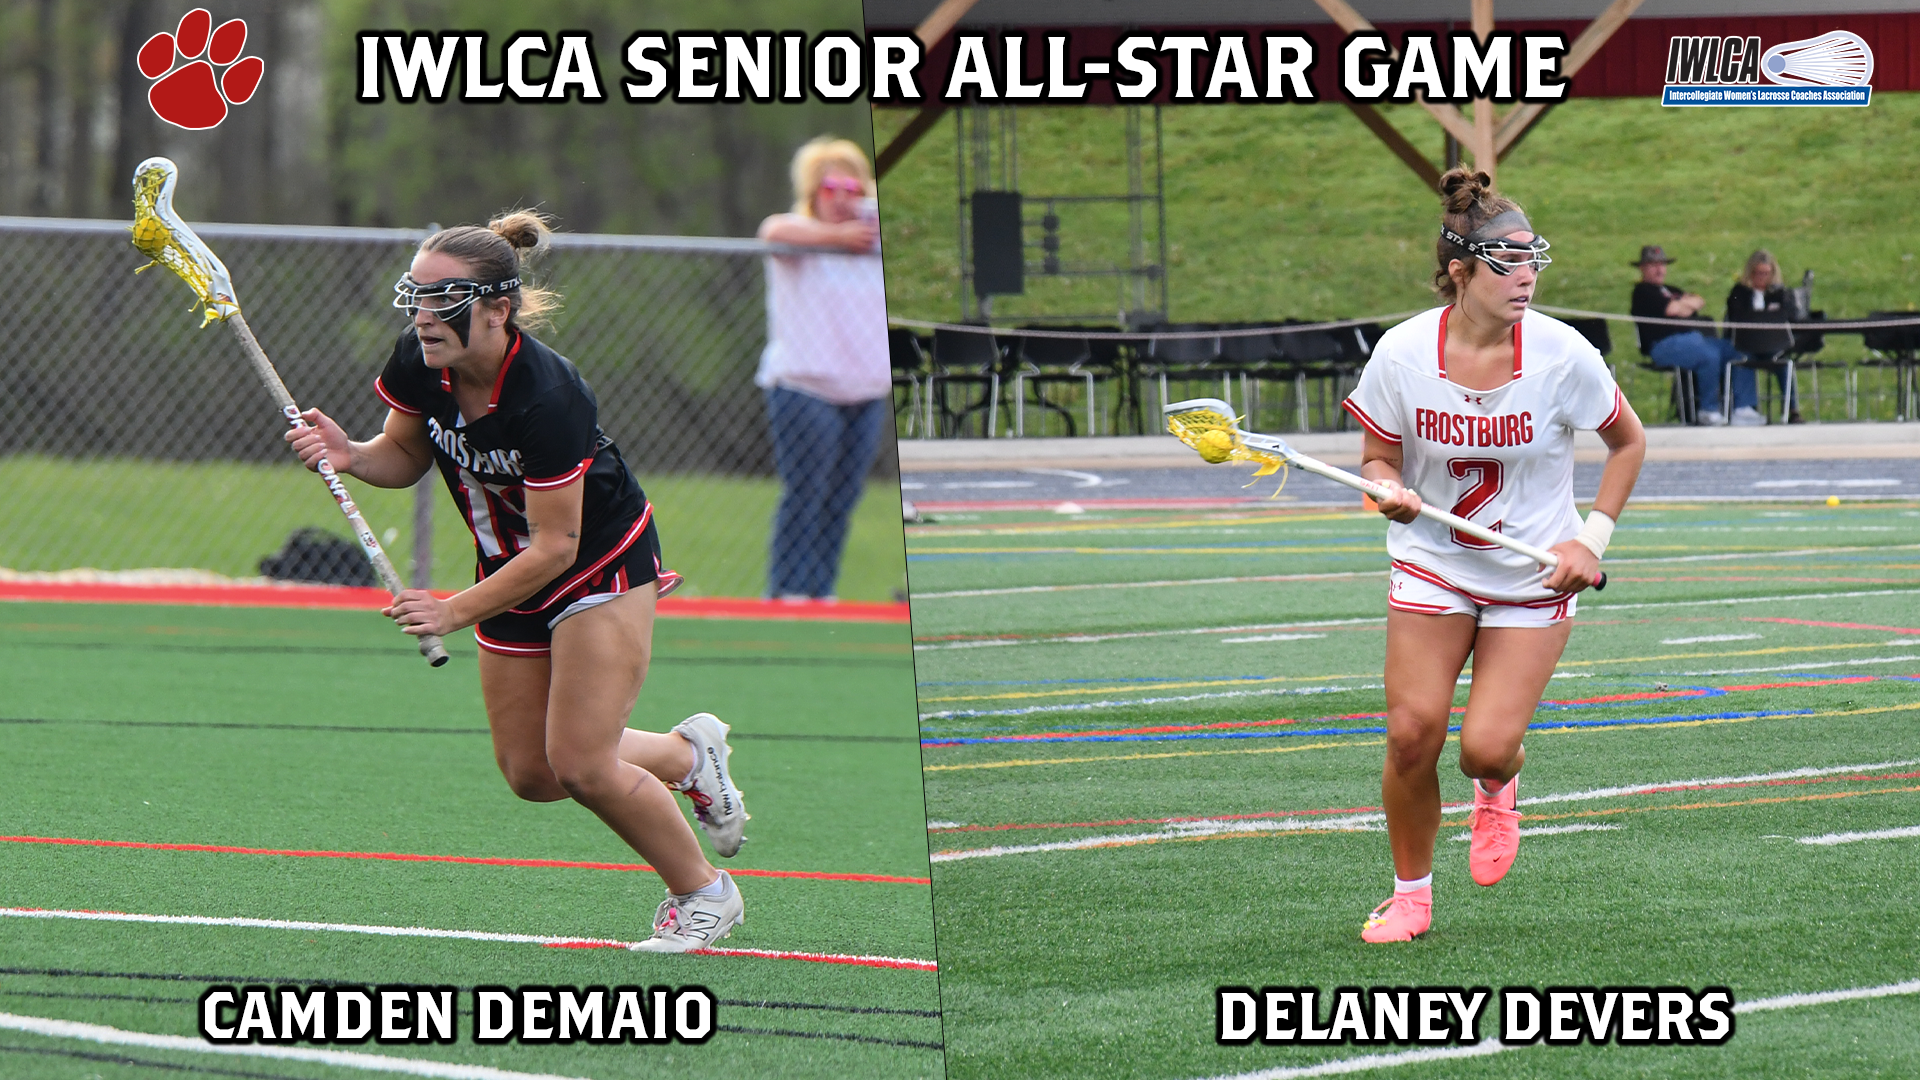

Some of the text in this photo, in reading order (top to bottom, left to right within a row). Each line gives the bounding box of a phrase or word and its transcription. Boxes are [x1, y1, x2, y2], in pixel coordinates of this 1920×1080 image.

[1446, 231, 1465, 246] STX
[477, 276, 520, 295] TX STX
[1416, 407, 1533, 448] FROSTBURG
[283, 404, 361, 520] DRONFLY
[1446, 457, 1504, 551] 2
[706, 746, 733, 816] new balance
